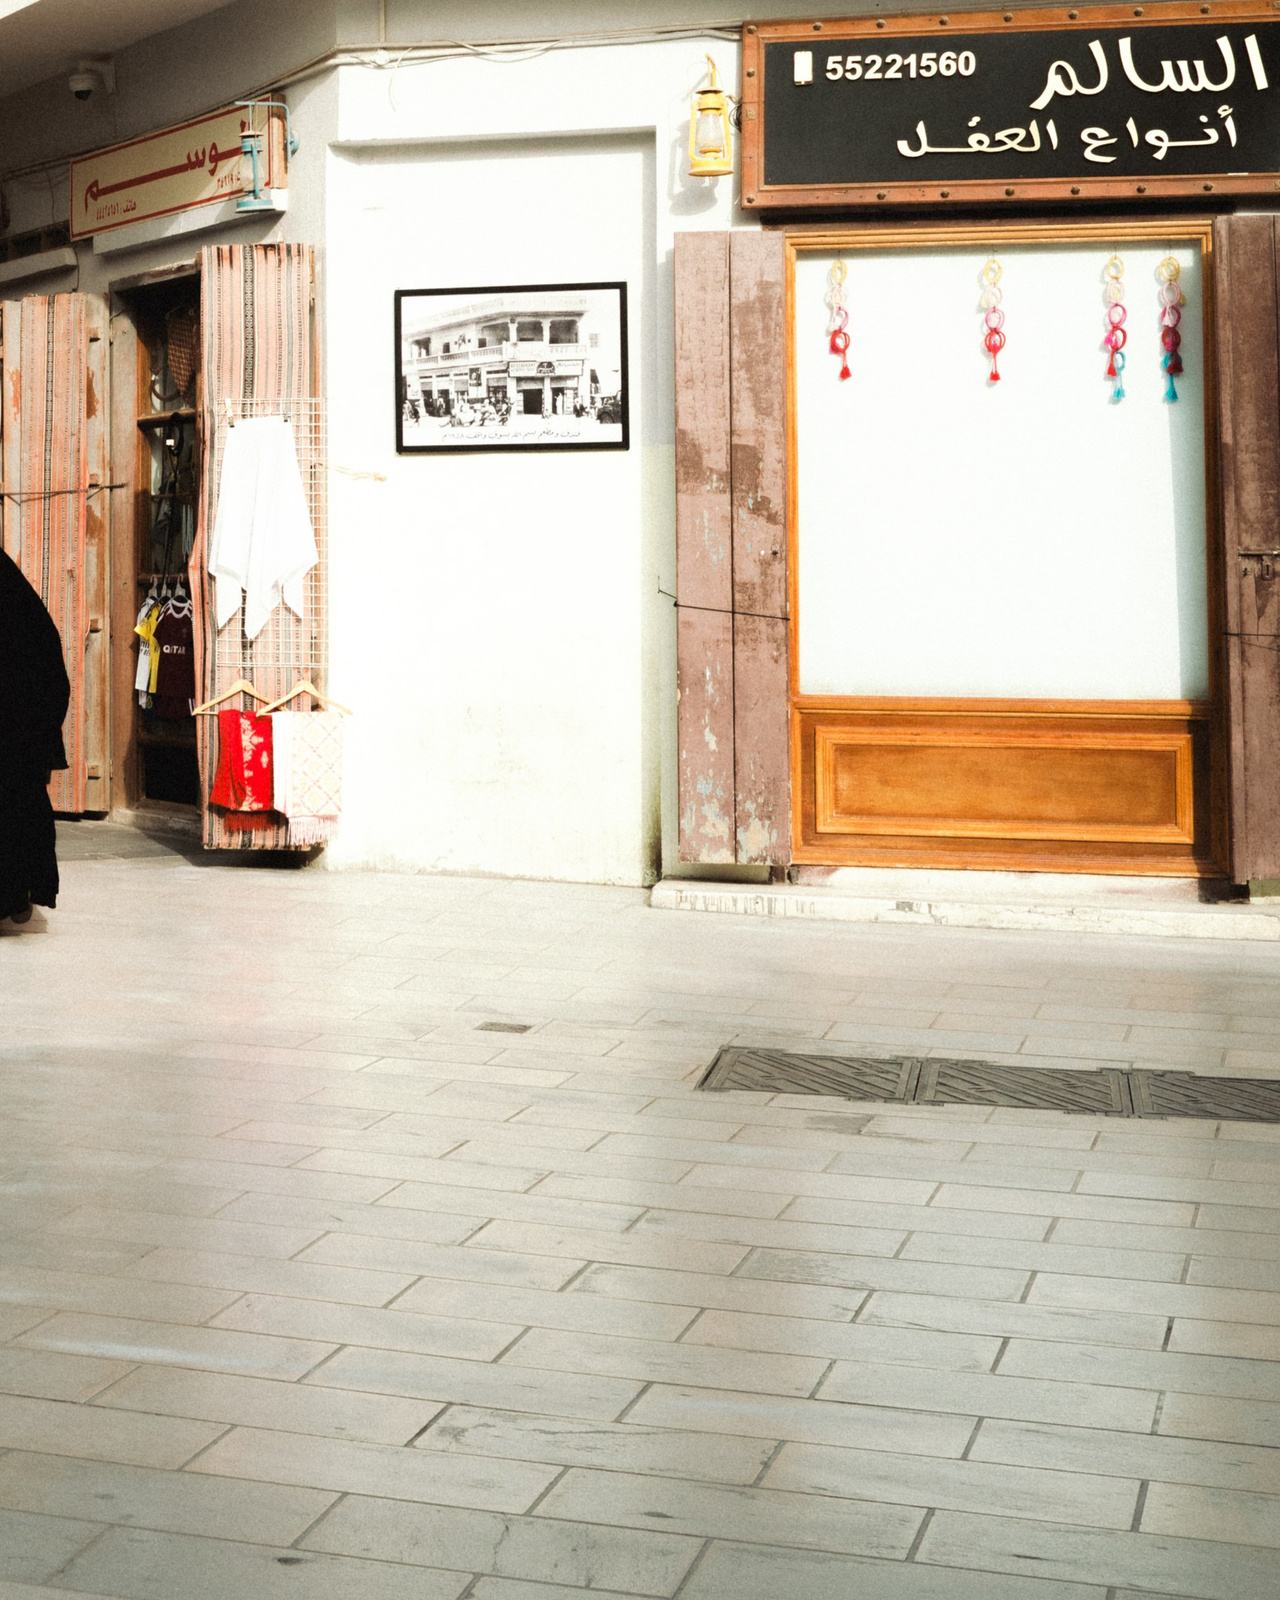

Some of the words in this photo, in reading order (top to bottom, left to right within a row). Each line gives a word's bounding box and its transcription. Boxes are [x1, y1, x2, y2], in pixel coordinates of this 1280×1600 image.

[825, 51, 976, 81] 55221560
[1029, 34, 1269, 110] السالم
[896, 116, 1059, 158] العقل
[1080, 104, 1238, 163] أنواع
